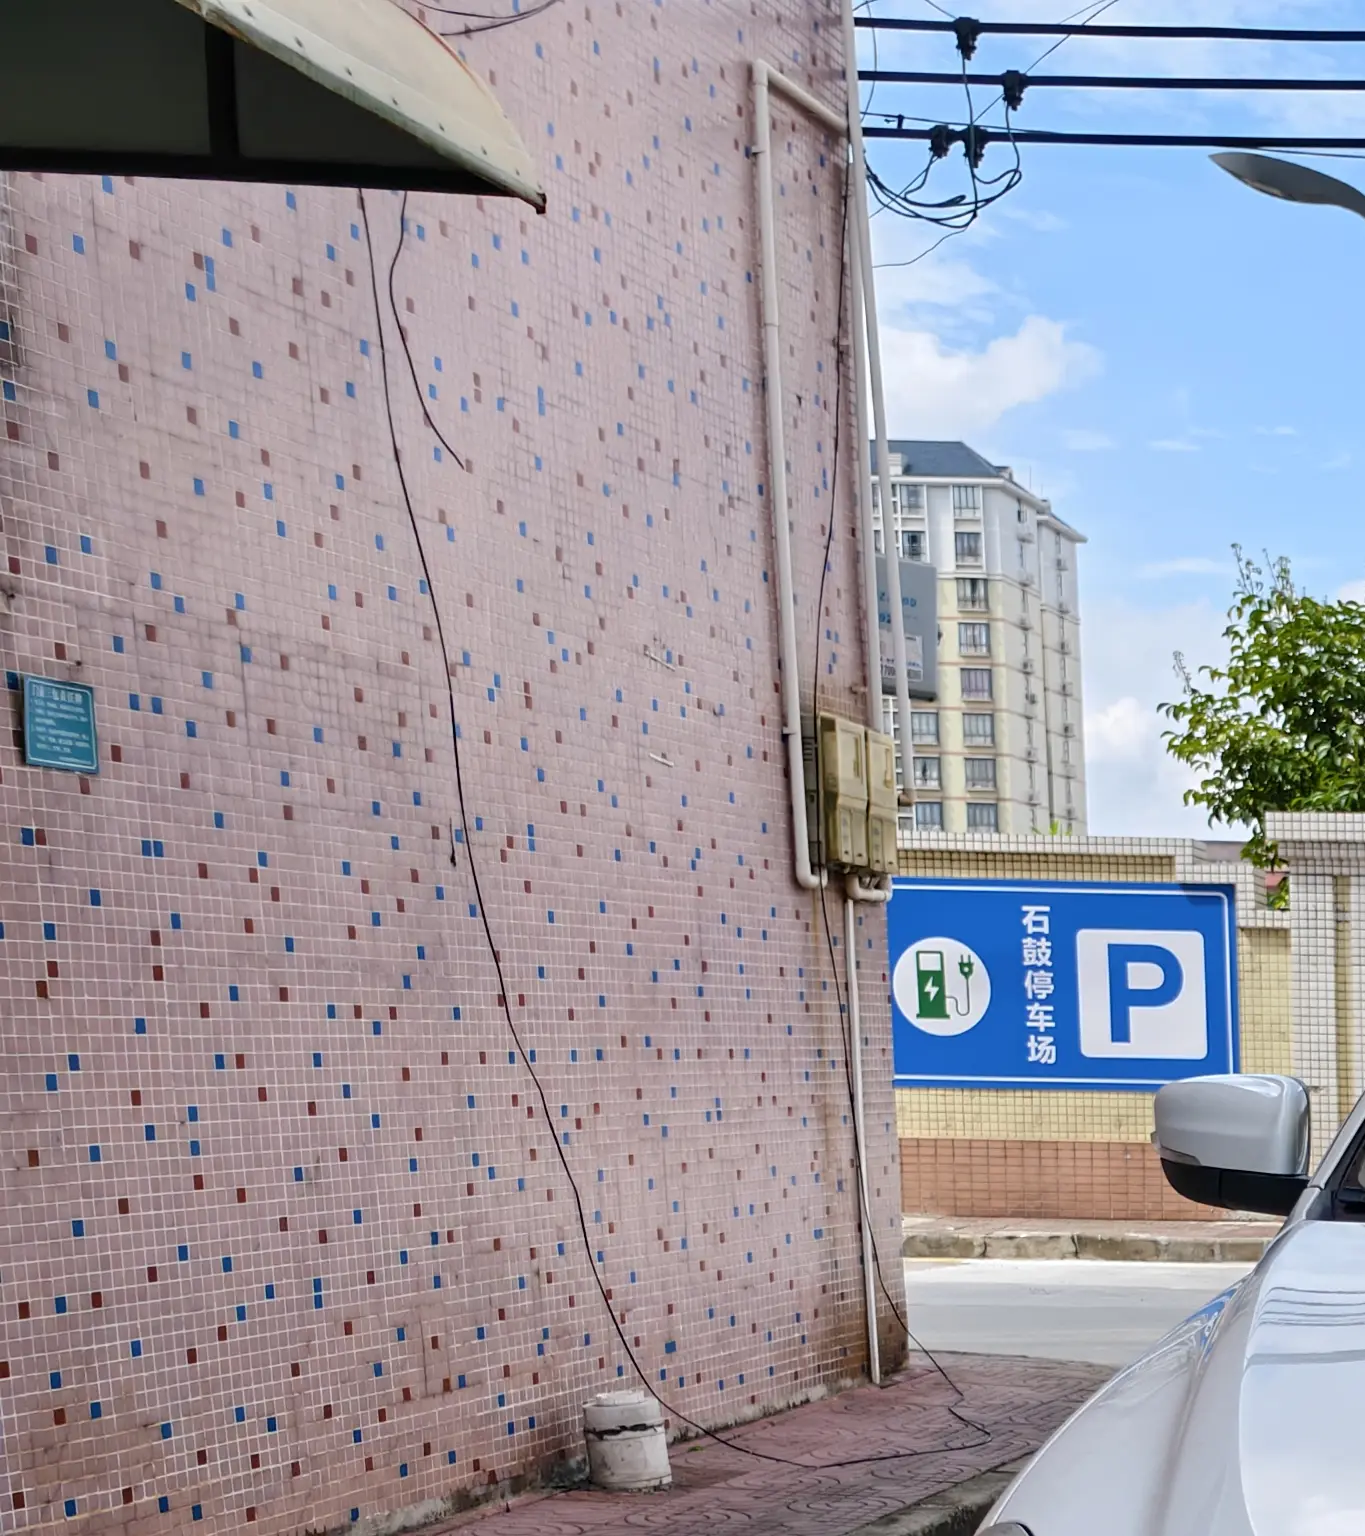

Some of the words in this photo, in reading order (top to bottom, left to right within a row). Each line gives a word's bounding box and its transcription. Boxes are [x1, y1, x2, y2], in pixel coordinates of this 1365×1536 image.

[1021, 904, 1057, 1064] 石鼓停车场
[1107, 943, 1184, 1044] P
